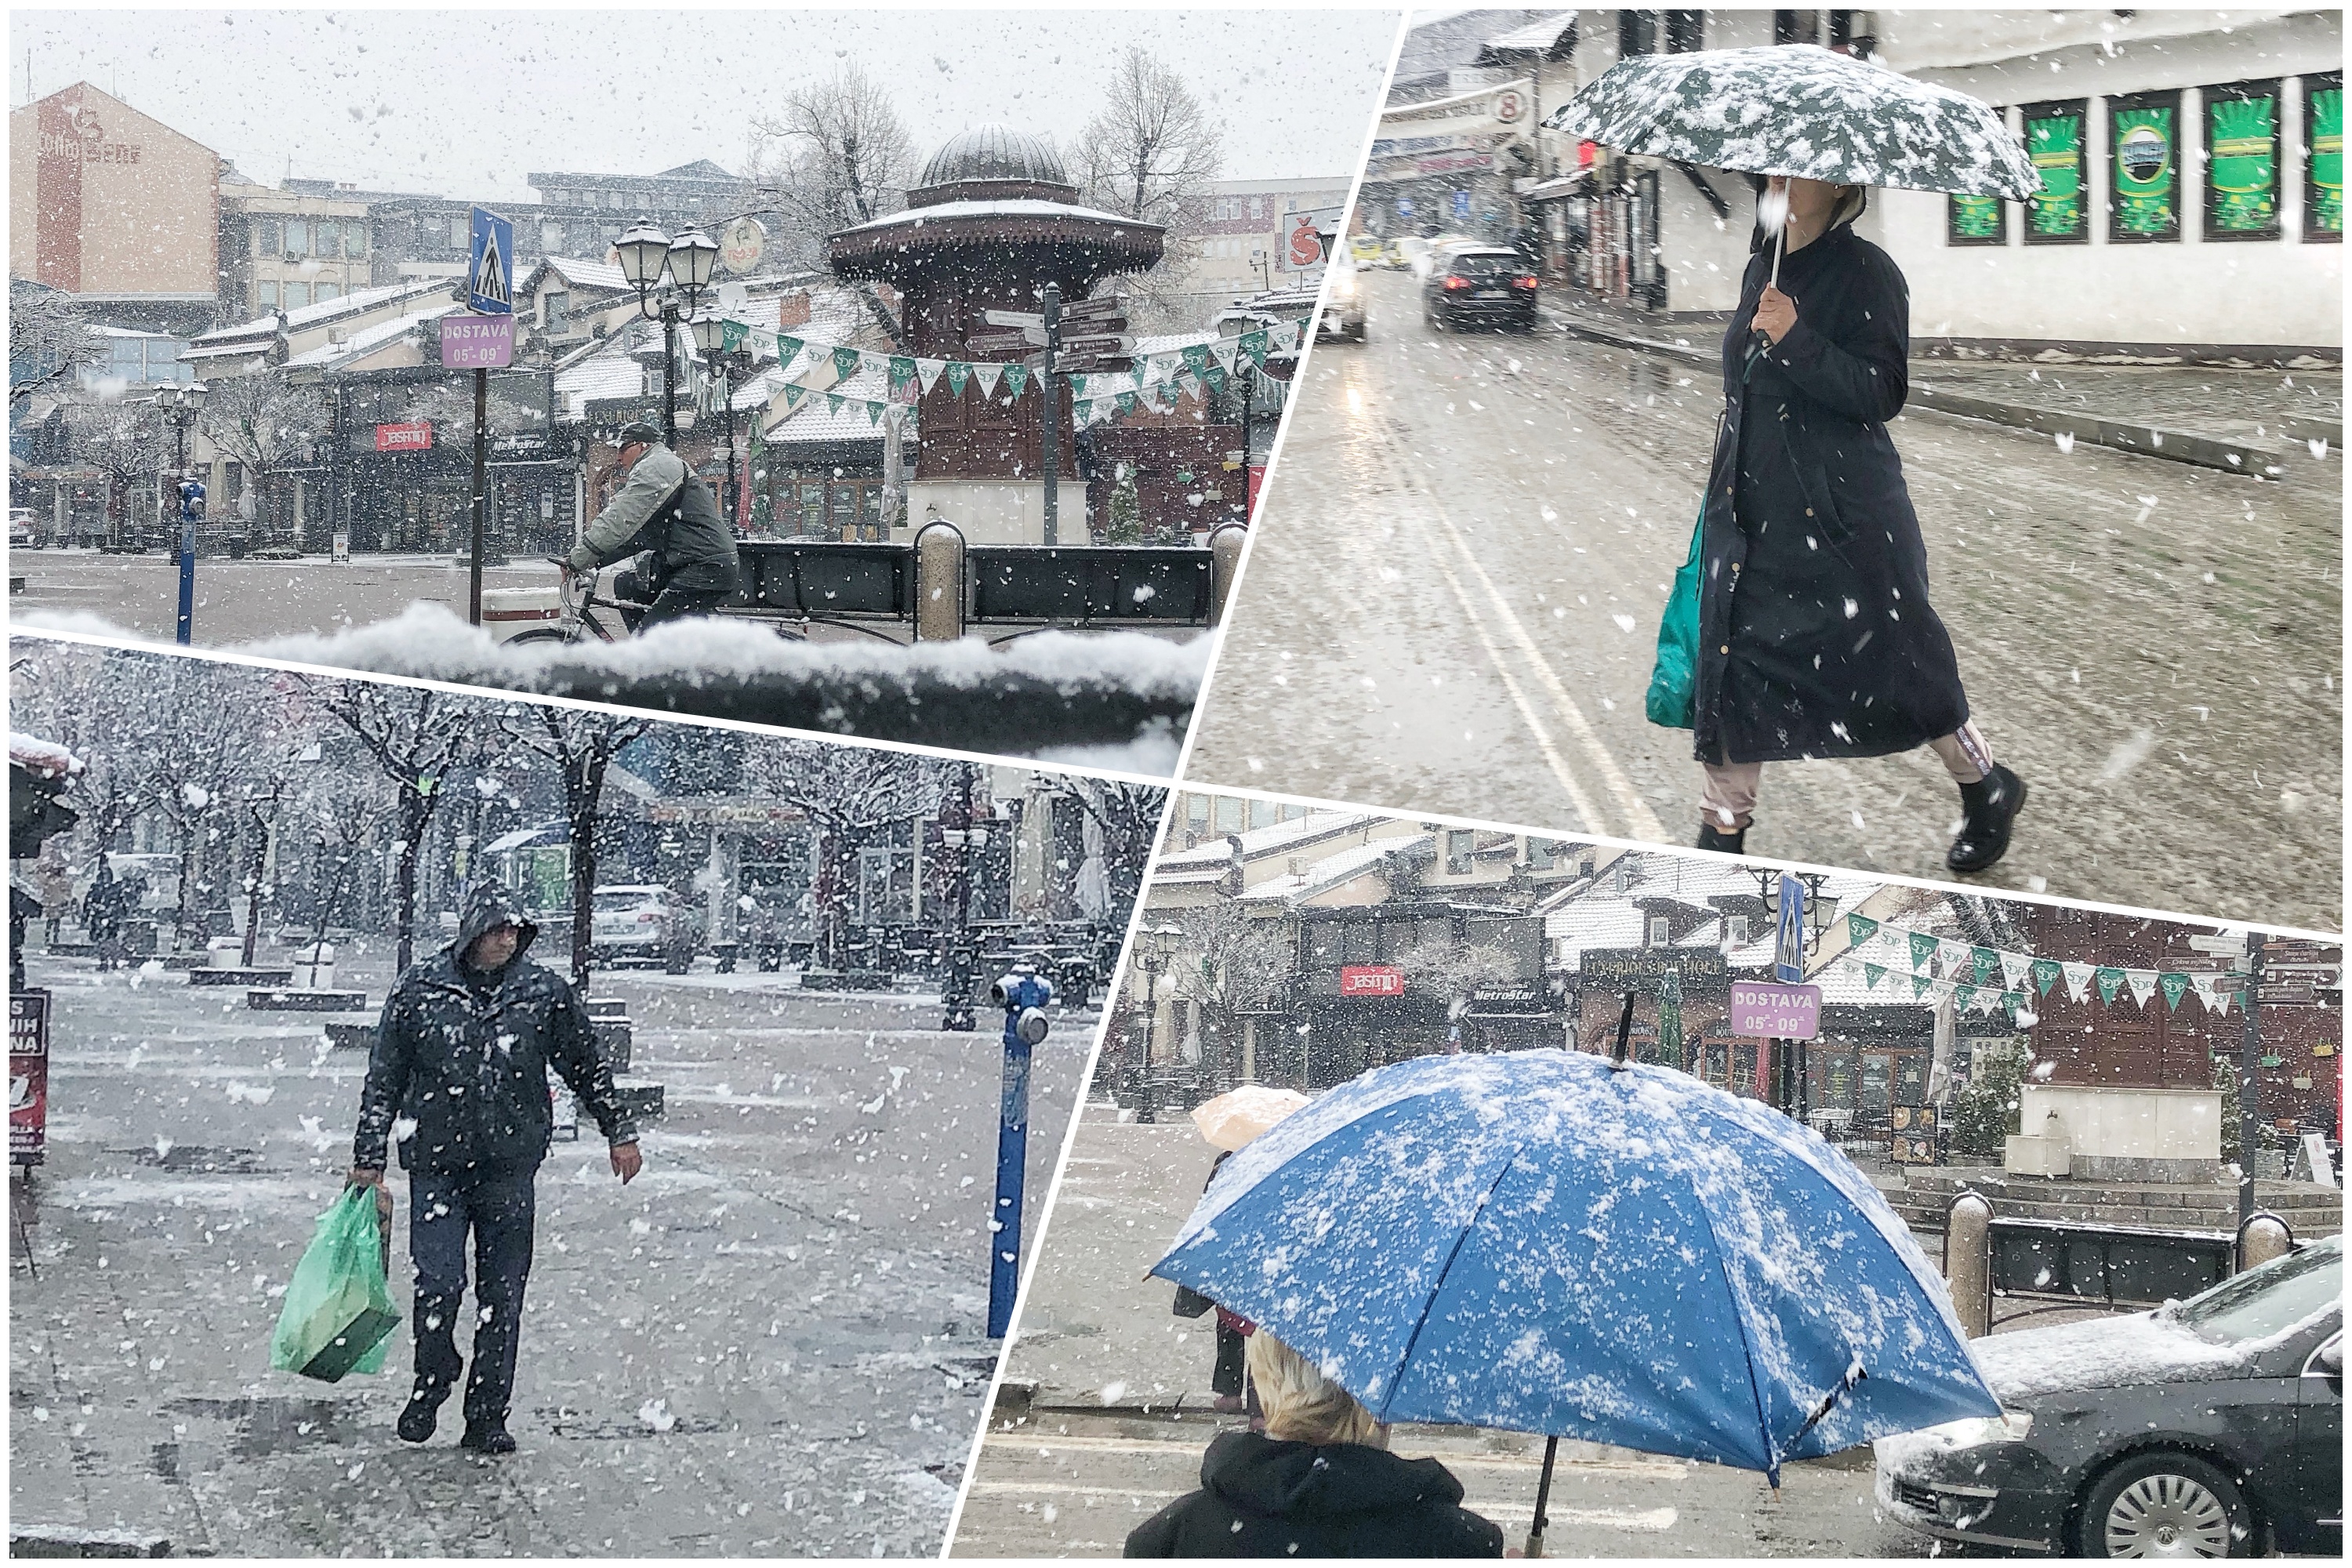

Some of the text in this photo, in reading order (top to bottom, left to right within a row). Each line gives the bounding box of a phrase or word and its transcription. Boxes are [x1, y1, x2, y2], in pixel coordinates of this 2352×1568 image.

[444, 324, 509, 339] DOSTAVA
[724, 326, 742, 342] SDP
[1277, 332, 1296, 343] SDP
[752, 335, 770, 349] SDP
[1246, 339, 1265, 351] SDP
[779, 343, 798, 356] SDP
[808, 349, 826, 362] SDP
[1217, 347, 1236, 359] SDP
[837, 354, 855, 368] SDP
[864, 358, 882, 372] SDP
[1156, 358, 1176, 370] SDP
[1185, 354, 1204, 365] SDP
[892, 364, 911, 377] SDP
[920, 366, 938, 379] SDP
[949, 369, 967, 382] SDP
[979, 370, 997, 382] SDP
[1131, 364, 1145, 376] DP
[1007, 370, 1026, 384] SDP
[1207, 373, 1221, 383] SDP
[767, 383, 779, 394] SDP
[1186, 380, 1200, 390] SDP
[788, 388, 800, 399] SDP
[808, 394, 821, 404] SDP
[1142, 393, 1155, 402] SDP
[849, 402, 862, 412] SDP
[1098, 401, 1112, 411] SDP
[1120, 397, 1134, 407] SDP
[869, 406, 882, 416] SDP
[890, 410, 903, 419] SDP
[1075, 405, 1090, 415] SDP
[492, 439, 547, 452] MetroStar
[1850, 921, 1870, 937] SDP
[1881, 931, 1900, 946] SDP
[1911, 941, 1932, 956] SDP
[1943, 949, 1962, 963] SDP
[1974, 955, 1994, 969] SDP
[1844, 961, 1858, 974] SDP
[2005, 960, 2024, 975] SDP
[1867, 969, 1882, 979] SDP
[1891, 975, 1904, 985] SDP
[2037, 967, 2057, 982] SDP
[2068, 971, 2088, 985] SDP
[1913, 981, 1926, 991] SDP
[2132, 977, 2152, 989] SDP
[2164, 979, 2184, 993] SDP
[2198, 979, 2212, 993] SD
[1473, 989, 1534, 1001] MetroStar
[1936, 985, 1950, 996] SDP
[1958, 990, 1971, 1000] SDP
[1735, 992, 1813, 1009] DOSTAVA
[1982, 993, 1996, 1004] SDP
[9, 1036, 38, 1051] NA
